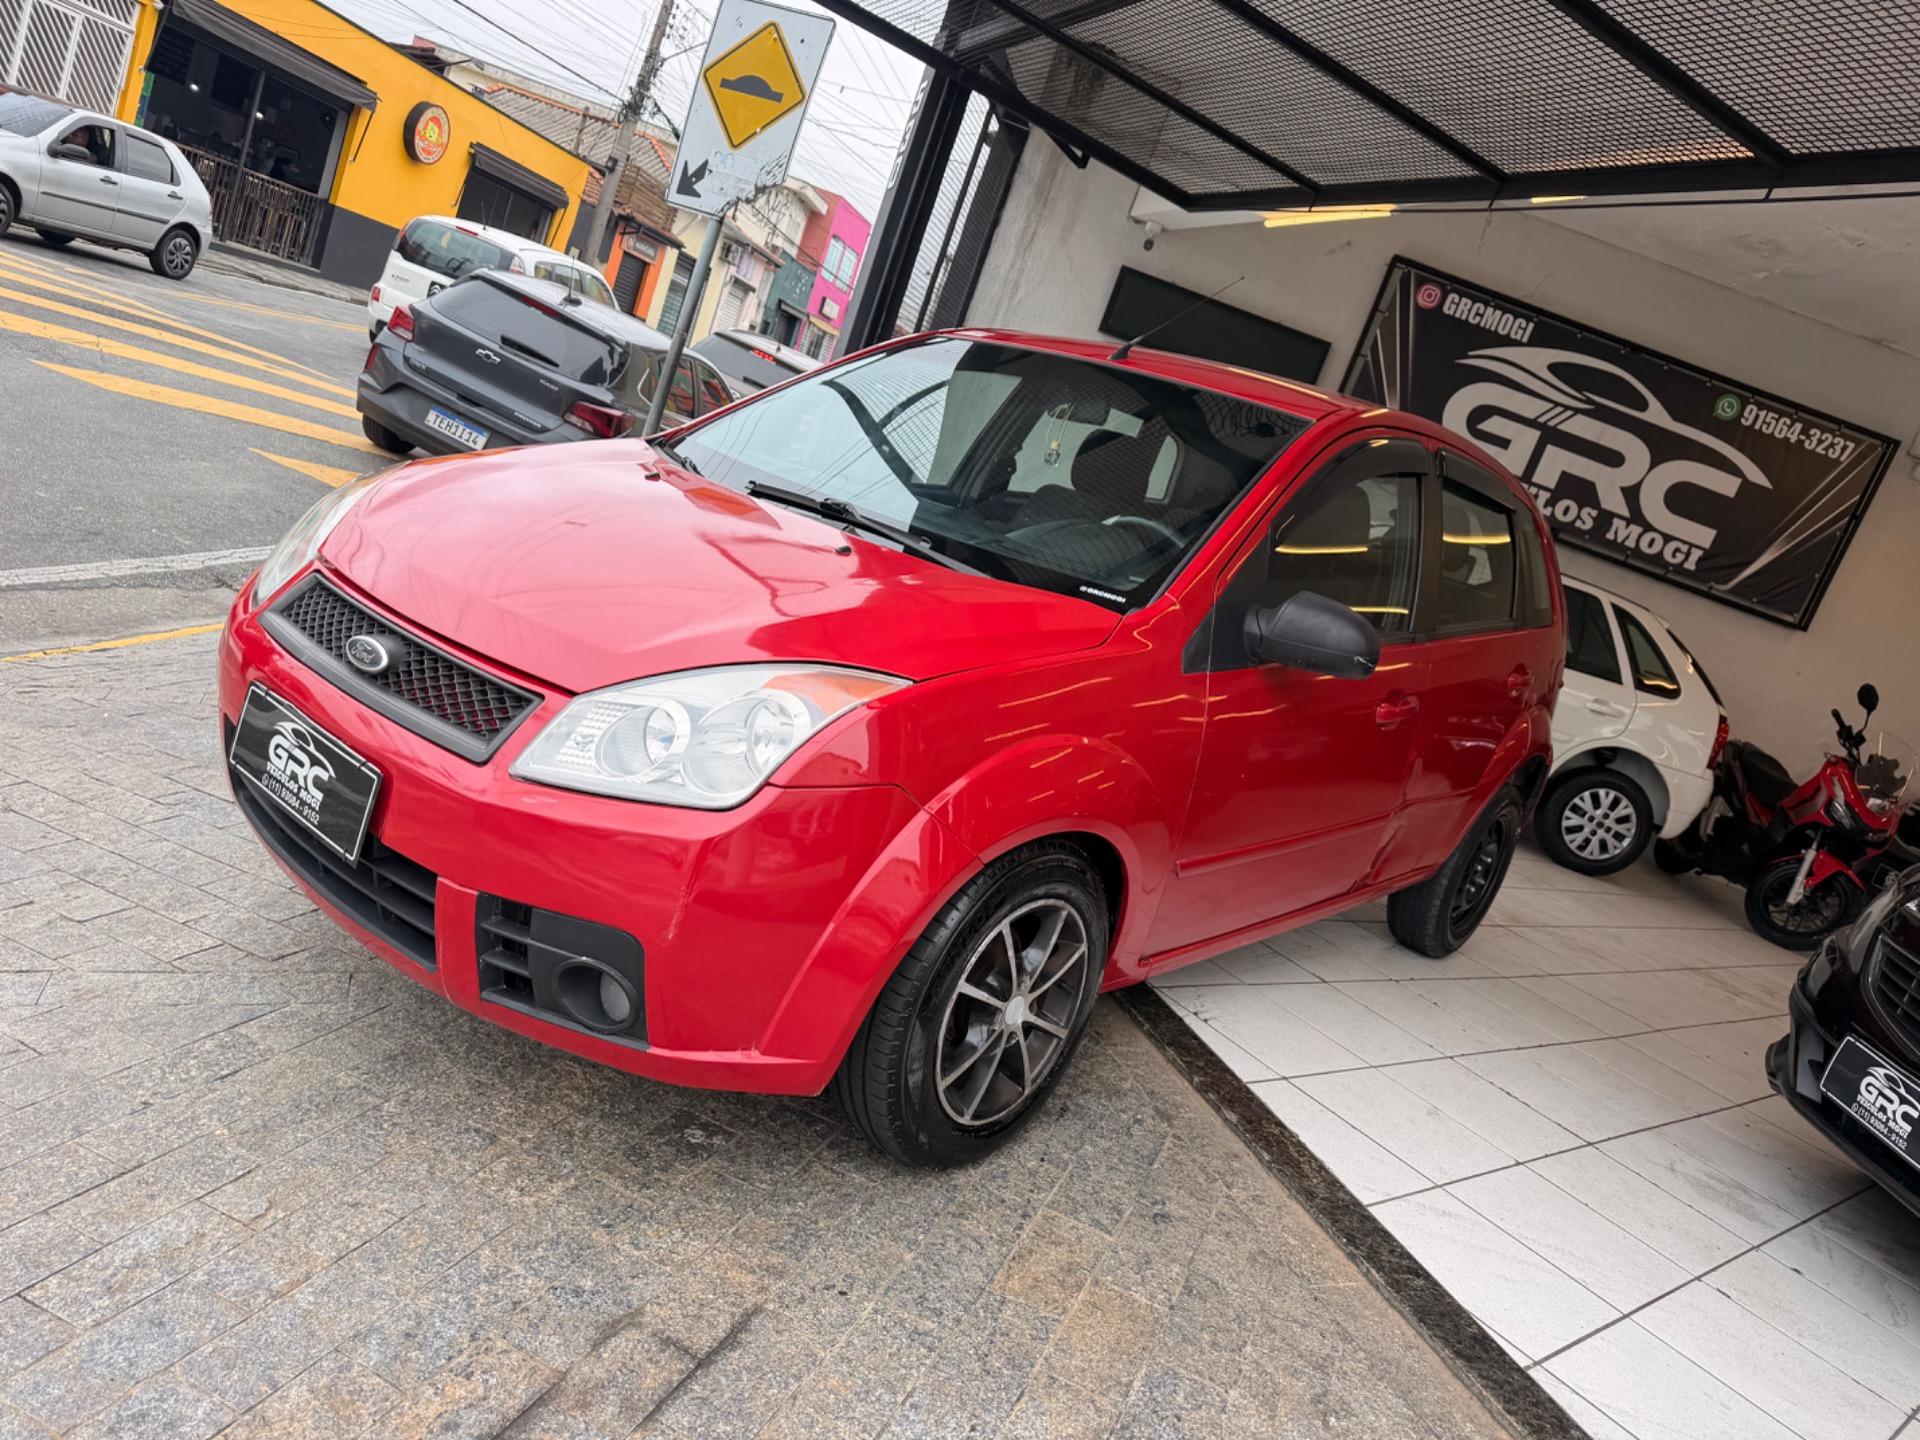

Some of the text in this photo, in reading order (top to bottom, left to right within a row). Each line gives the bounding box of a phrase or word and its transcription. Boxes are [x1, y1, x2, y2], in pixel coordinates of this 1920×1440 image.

[1443, 292, 1535, 344] GRCMOGI
[1740, 403, 1856, 463] 91564-3237
[1443, 382, 1743, 548] GRC
[1606, 517, 1704, 572] MOGI
[351, 640, 375, 663] Ford
[267, 761, 320, 811] VEICULOS MOGI
[268, 734, 329, 802] GRC
[269, 777, 281, 796] (11)
[1860, 1076, 1919, 1133] GRC
[1888, 1120, 1908, 1139] MOGI
